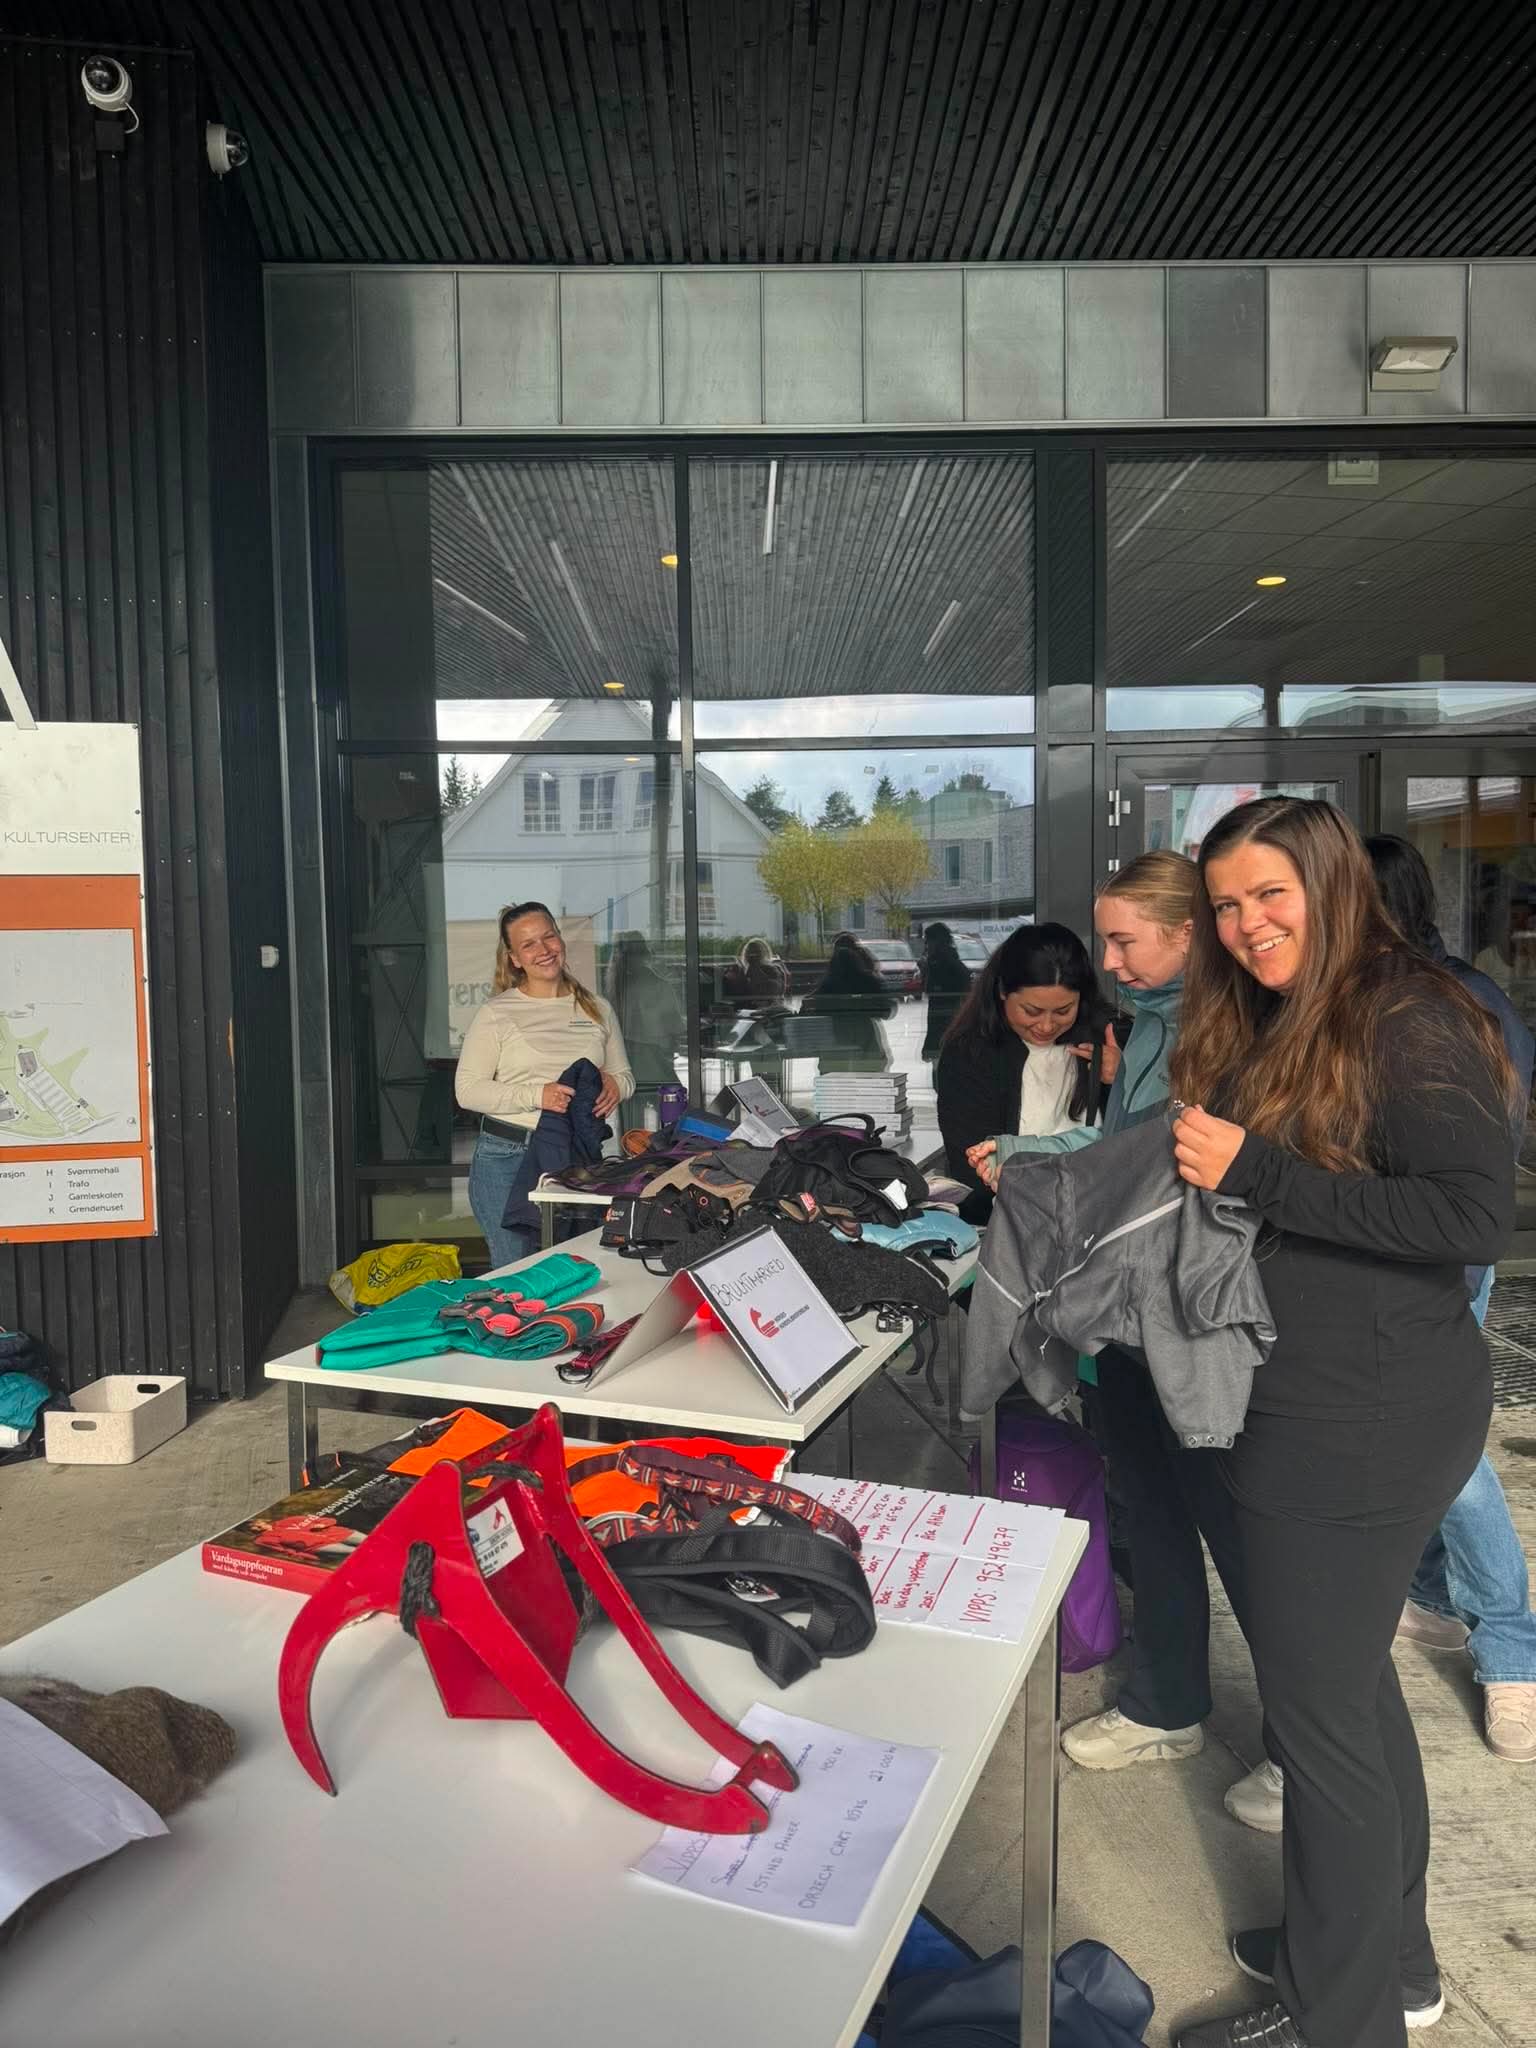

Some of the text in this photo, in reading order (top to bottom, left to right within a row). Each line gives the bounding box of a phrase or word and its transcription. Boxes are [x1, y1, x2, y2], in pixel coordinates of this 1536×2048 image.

[4, 831, 131, 843] KULTURSENTER
[46, 1166, 120, 1176] H Svømmehall
[68, 1180, 90, 1188] Trafo
[68, 1191, 123, 1201] Gamleskolen
[48, 1203, 123, 1214] K Grendehuset
[710, 1258, 785, 1307] BRUKTMARKED
[976, 1526, 1019, 1582] 95249679
[211, 1550, 283, 1576] Vardagsuppfostran
[959, 1587, 998, 1623] VIPPS:
